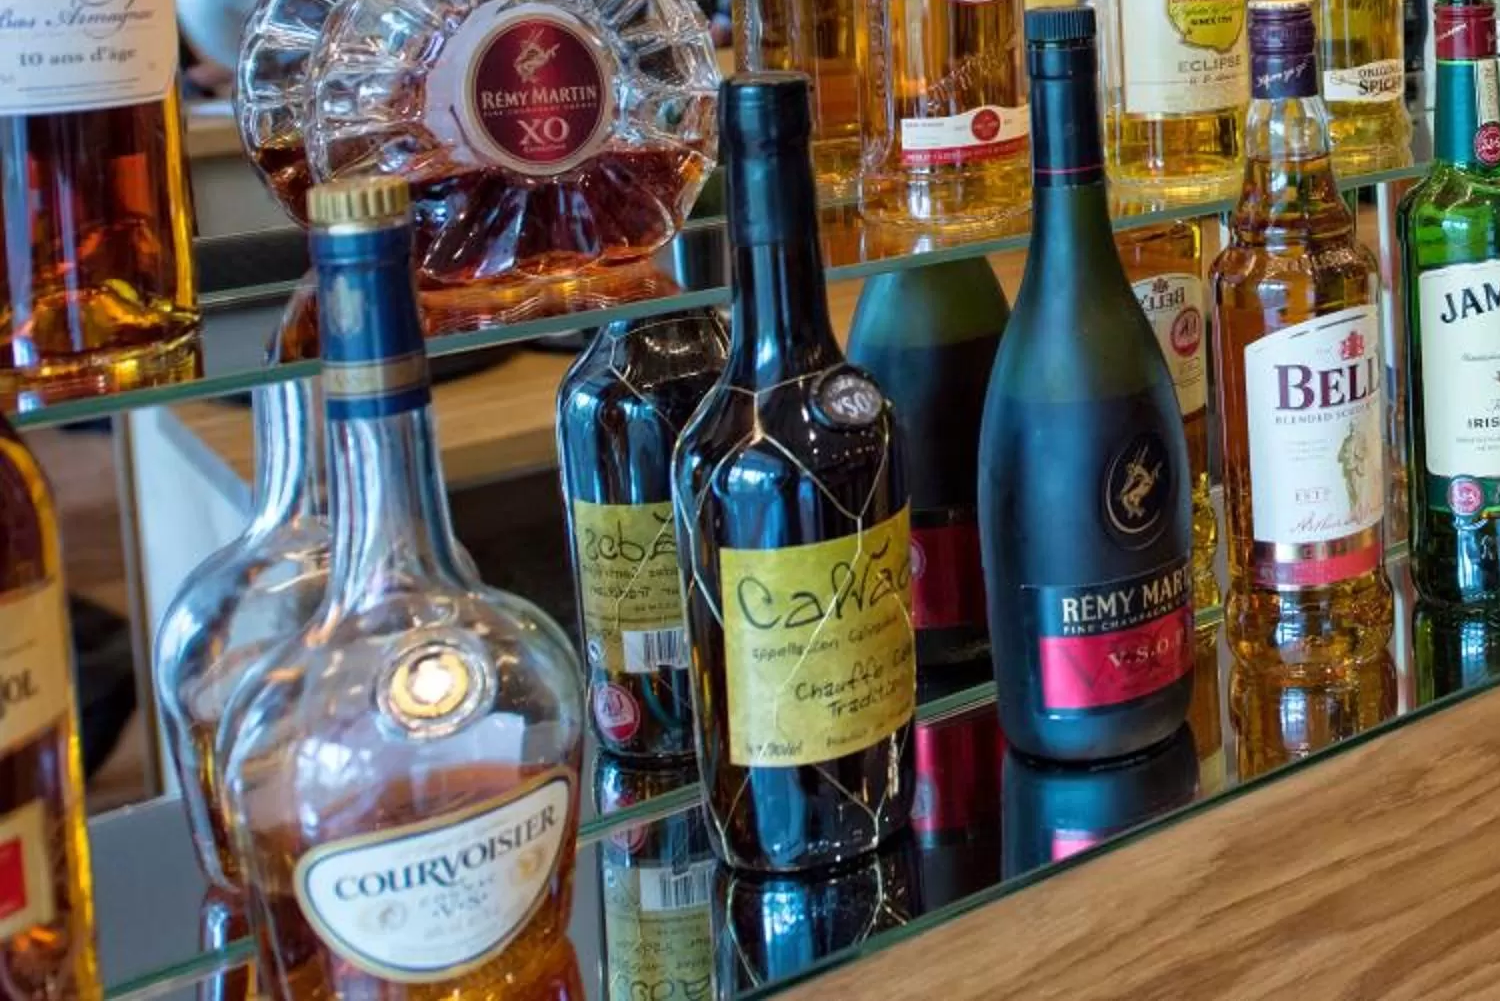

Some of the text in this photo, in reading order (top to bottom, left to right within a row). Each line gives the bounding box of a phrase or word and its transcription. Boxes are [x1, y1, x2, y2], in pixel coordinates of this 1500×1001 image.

[19, 53, 44, 68] 10
[531, 85, 598, 104] MARTIN
[516, 116, 571, 146] XO
[334, 804, 557, 901] COURVOISIER
